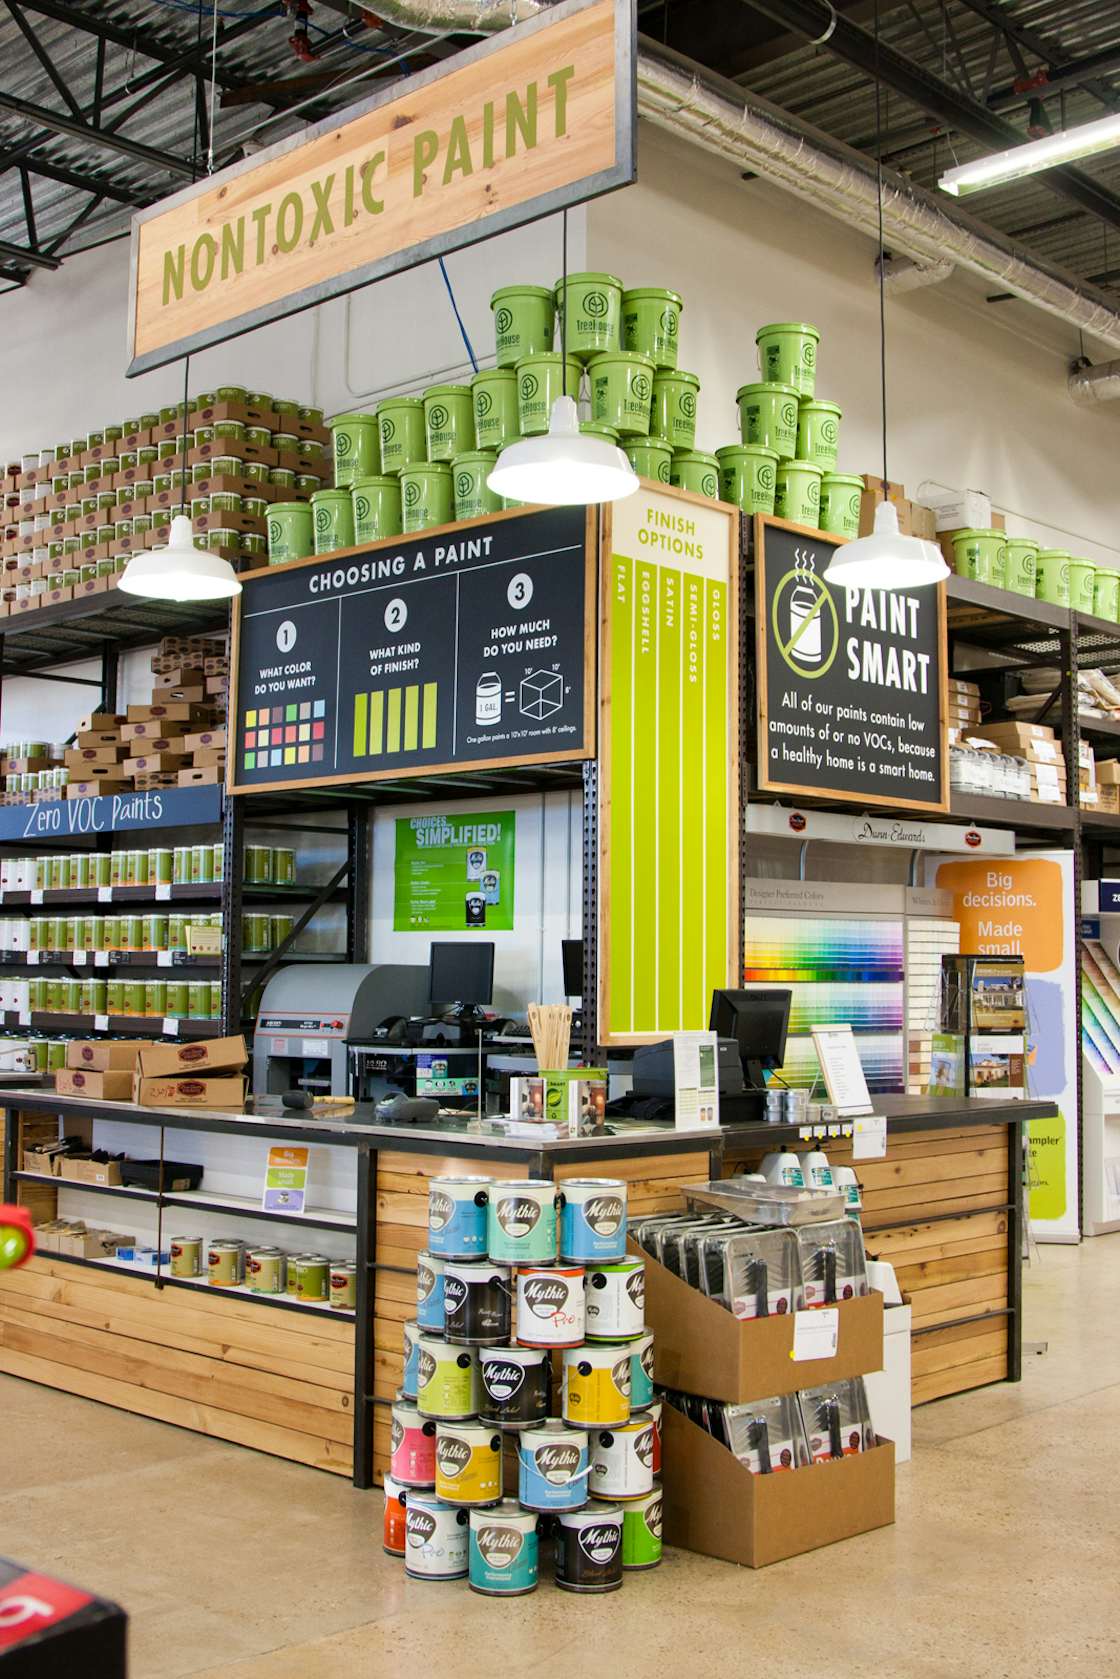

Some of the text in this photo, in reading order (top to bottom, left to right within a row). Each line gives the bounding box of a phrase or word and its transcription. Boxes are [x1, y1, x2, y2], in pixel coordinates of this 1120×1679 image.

[161, 64, 575, 305] NONTOXIC PAINT
[646, 508, 696, 536] FINISH
[637, 528, 704, 560] OPTIONS
[309, 536, 493, 593] CHOOSING A PAINT
[515, 582, 525, 601] 3
[617, 564, 626, 603] FLAT
[641, 571, 650, 654] EGGSHELL
[666, 576, 675, 627] SATIN
[391, 607, 401, 624] 2
[712, 589, 720, 641] GLOSS
[845, 587, 920, 639] PAINT
[491, 619, 550, 640] HOW MUCH
[689, 583, 698, 683] SEMI-GLOSS
[369, 642, 421, 660] WHAT KIND
[483, 635, 558, 658] DO YOU NEED?
[259, 661, 312, 679] WHAT COLOR
[370, 658, 420, 676] OF FINISH?
[847, 637, 930, 694] SMART
[254, 675, 316, 695] DO YOU WANT?
[782, 691, 925, 732] All of our paints contain low
[769, 717, 936, 758] amounts of or no VOCs, because
[771, 742, 936, 782] a healthy home is a smart home.
[23, 791, 163, 838] Zero VOC Paints
[416, 823, 502, 849] SIMPLIFIED!
[986, 871, 1013, 889] Big
[962, 891, 1037, 908] decisions.
[978, 921, 1023, 937] Made
[496, 1200, 539, 1220] Mythic
[583, 1200, 623, 1220] Mythic
[524, 1282, 567, 1302] Mythic
[483, 1363, 521, 1383] Mythic
[535, 1449, 580, 1471] Mythic
[478, 1529, 522, 1551] Mythic
[580, 1531, 619, 1550] Mythic
